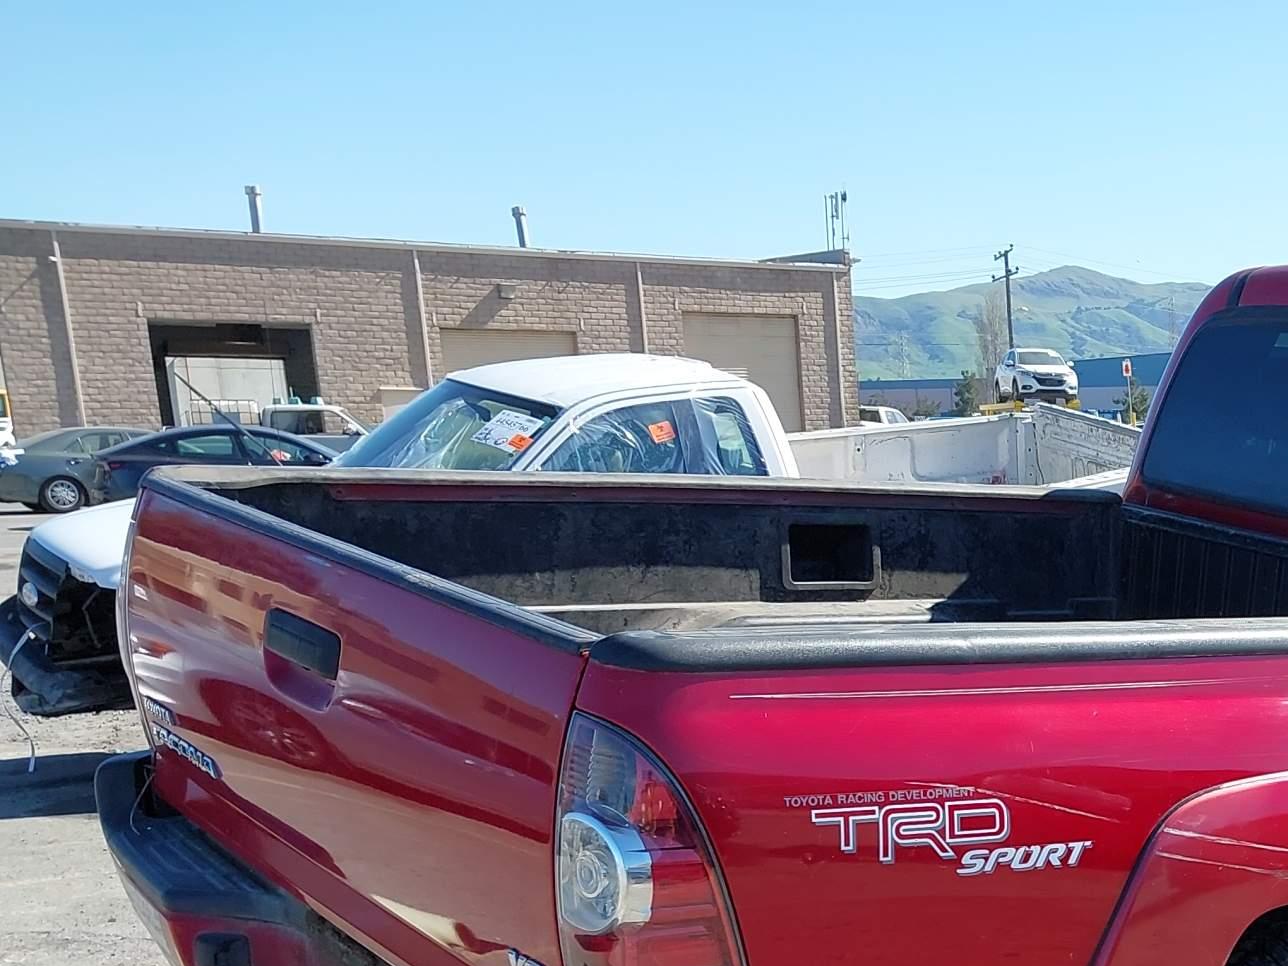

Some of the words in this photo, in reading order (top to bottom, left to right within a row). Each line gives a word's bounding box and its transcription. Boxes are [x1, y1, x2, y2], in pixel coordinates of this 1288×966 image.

[152, 727, 218, 779] TACOMA
[784, 794, 834, 808] TOYOTA
[837, 791, 885, 805] RACING
[889, 786, 976, 802] DEVELOPMENT
[811, 798, 1011, 864] TRD
[956, 840, 1093, 876] SPORT
